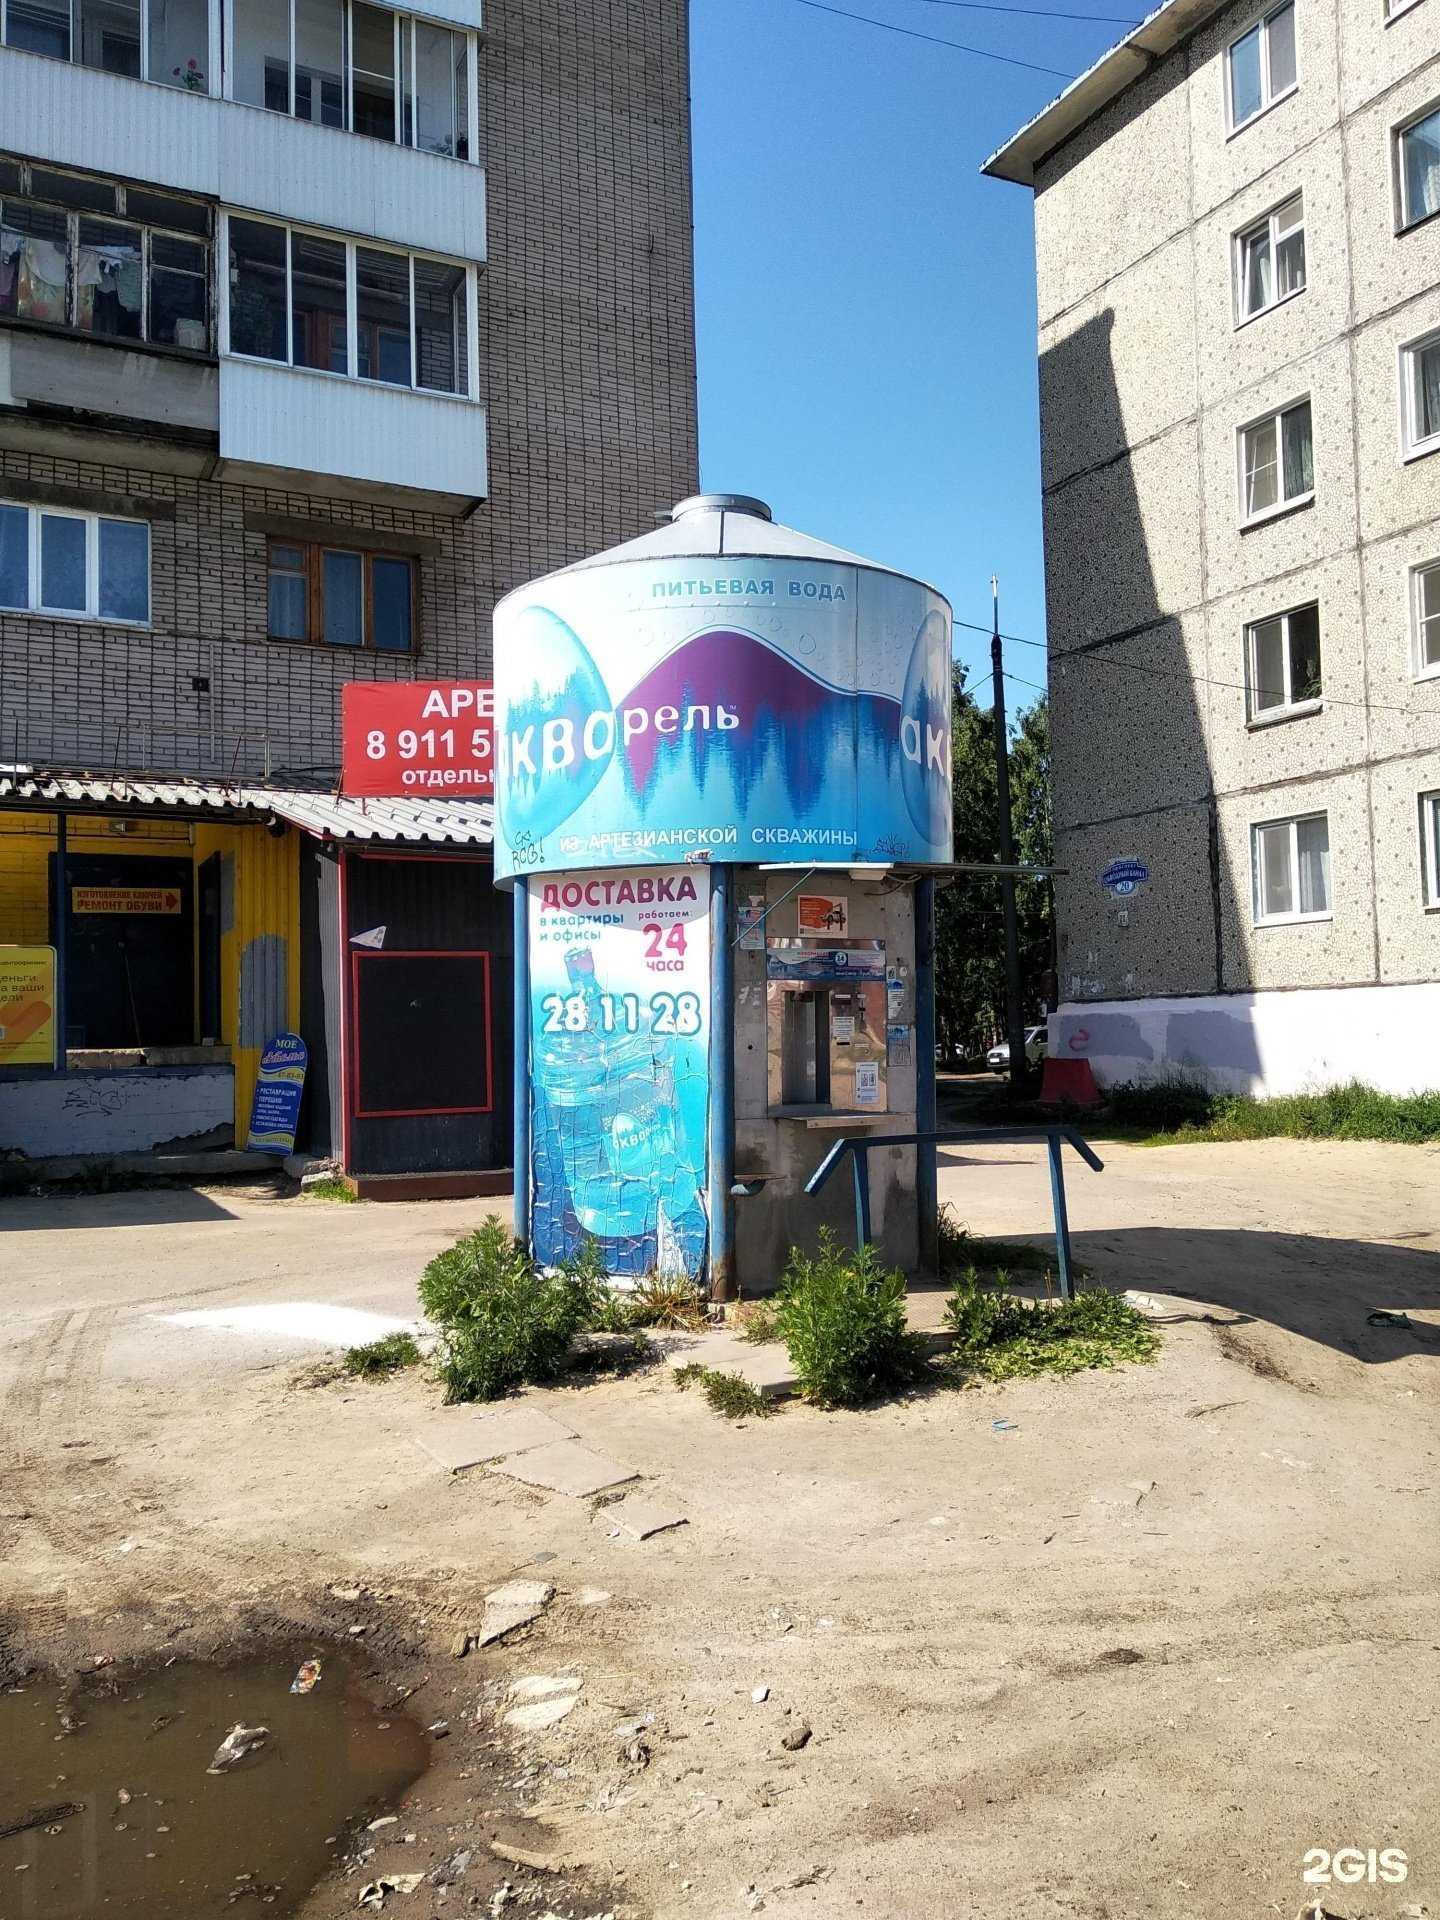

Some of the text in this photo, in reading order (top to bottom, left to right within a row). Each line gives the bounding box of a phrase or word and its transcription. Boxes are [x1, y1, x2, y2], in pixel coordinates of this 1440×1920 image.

[652, 579, 846, 602] ПИТЬЕВАЯ ВОДА
[366, 729, 491, 760] 8 911 5
[588, 825, 737, 849] АРТЕЗИАНСКОЙ
[752, 827, 858, 846] СКВАЖИНЫ
[541, 875, 697, 912] ДОСТАВКА
[77, 900, 162, 912] РЕМОНТ ОБУВИ
[540, 914, 624, 930] в квартиры
[553, 929, 600, 944] офисы
[643, 923, 687, 957] 24
[646, 960, 684, 971] часа
[0, 975, 37, 984] еньги
[542, 992, 702, 1036] 28 11 28
